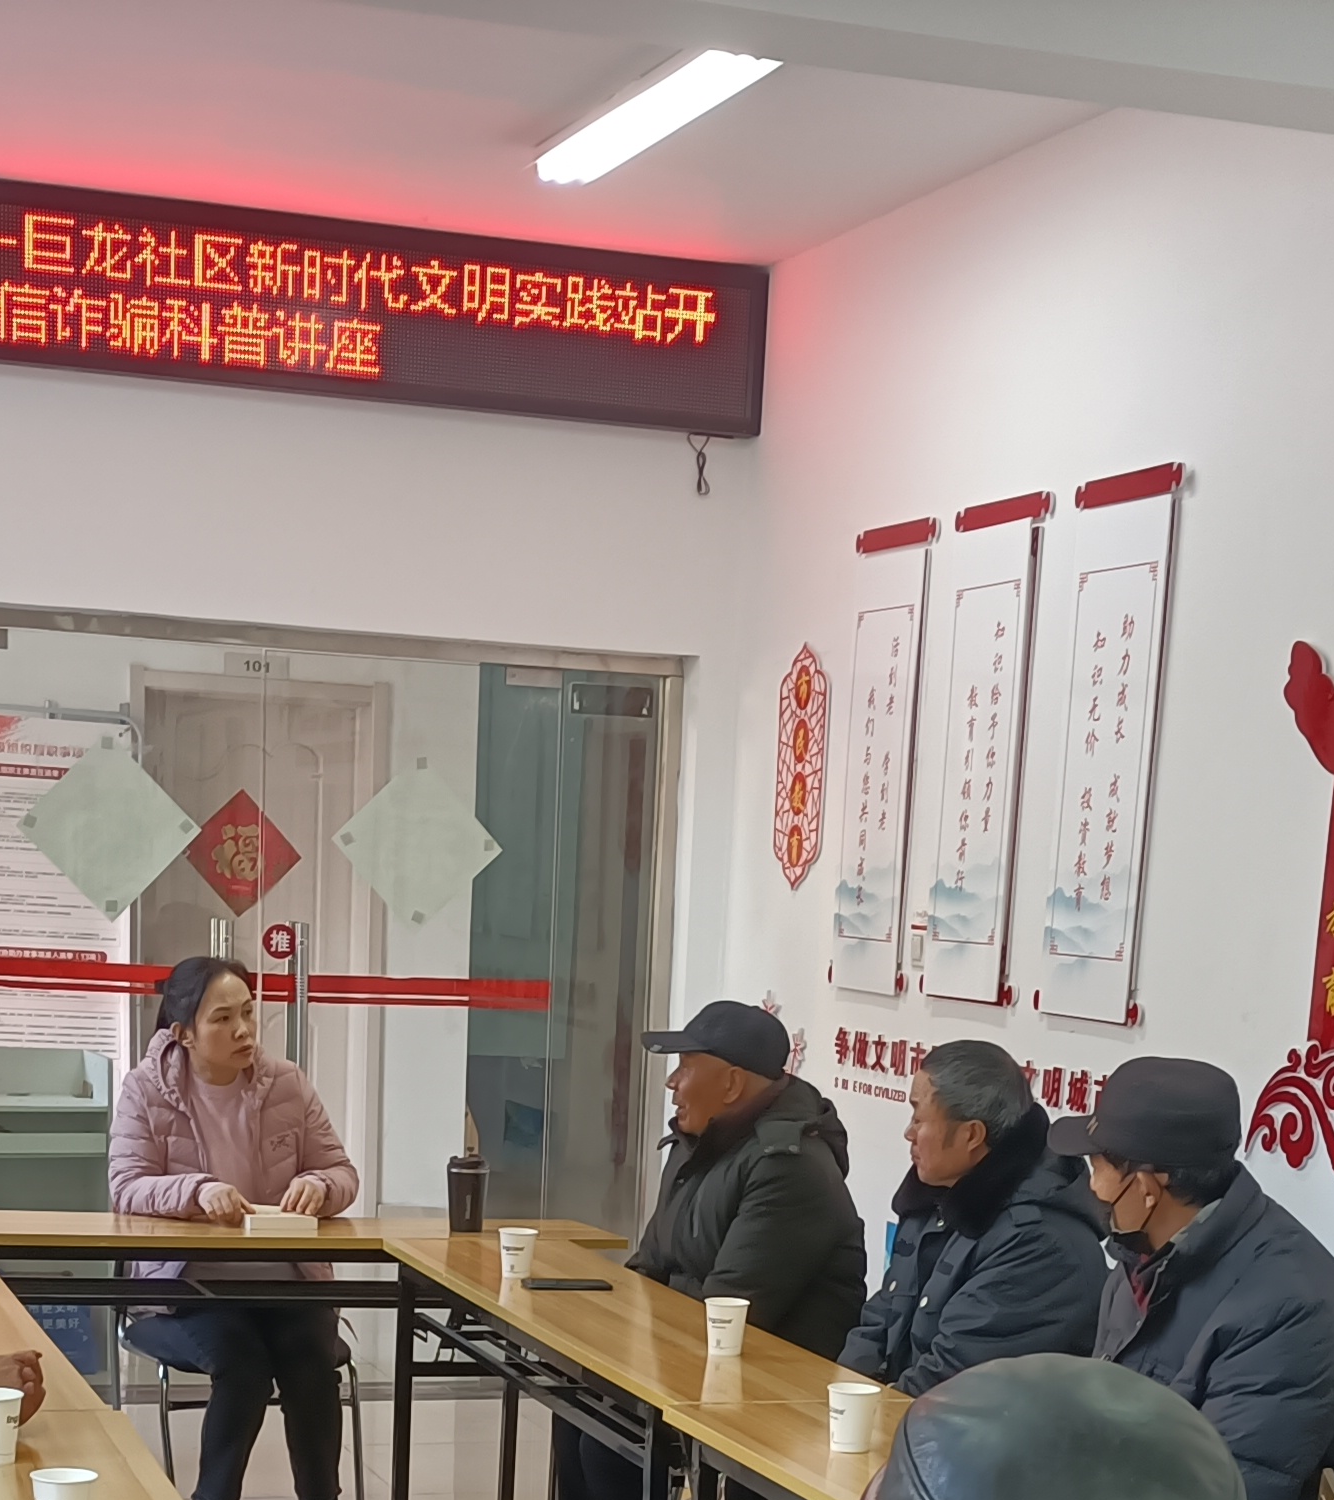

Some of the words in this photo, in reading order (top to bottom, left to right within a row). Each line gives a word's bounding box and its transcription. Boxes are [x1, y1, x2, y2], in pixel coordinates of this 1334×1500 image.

[243, 660, 270, 673] 101
[1085, 631, 1106, 757] 知识无价
[1114, 613, 1135, 744] 助力成长
[981, 620, 1005, 833] 知识给予你力量
[211, 824, 264, 881] 福
[1099, 773, 1120, 901] 成就梦想
[269, 931, 291, 952] 推
[834, 1027, 939, 1077] 争做文明市
[858, 1082, 872, 1096] FOR
